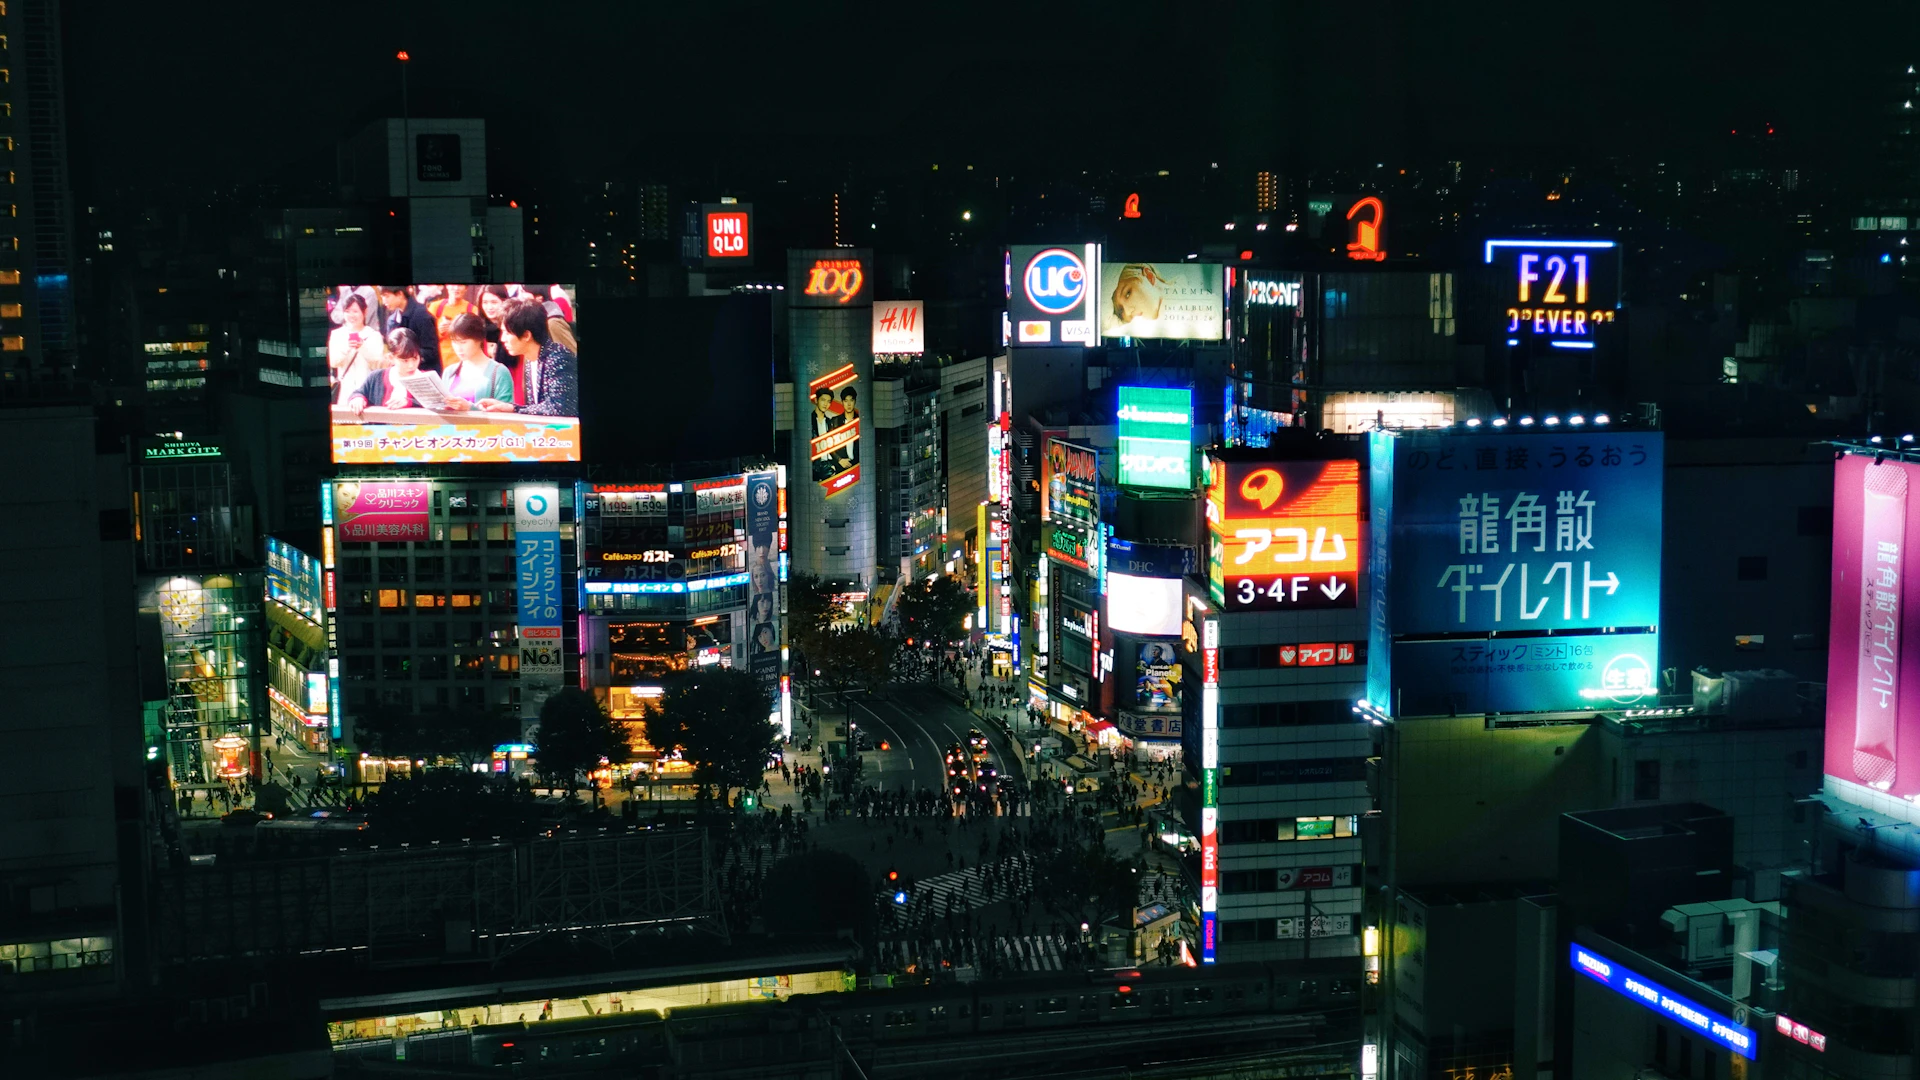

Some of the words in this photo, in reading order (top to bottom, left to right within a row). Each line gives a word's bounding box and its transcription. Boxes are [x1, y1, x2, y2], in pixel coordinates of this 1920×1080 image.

[713, 218, 740, 234] UNI
[714, 236, 744, 253] QLO
[804, 268, 864, 303] 109
[1032, 266, 1082, 298] UC
[1520, 254, 1587, 303] F21
[880, 307, 918, 332] H&M
[1066, 327, 1090, 335] VISA
[532, 438, 556, 447] 12.2
[377, 489, 423, 498] 品川スキン
[377, 499, 419, 508] クリニック
[586, 500, 598, 509] 9F
[521, 518, 554, 527] eyecity
[1459, 490, 1596, 554] 龍角散
[352, 524, 425, 536] 品川美容外科
[720, 544, 743, 557] ガスト
[1236, 527, 1347, 564] アコム
[643, 550, 674, 562] ガスト
[587, 567, 602, 576] 7F
[624, 565, 662, 579] ガスト
[1129, 560, 1154, 572] DHC
[522, 540, 540, 618] アイシティ
[543, 540, 557, 618] コンタクトの
[1437, 561, 1620, 623] ダイレクト
[521, 648, 562, 665] No.1
[1300, 648, 1352, 662] アイフル
[1452, 644, 1528, 662] スティック
[1534, 646, 1564, 658] ミント
[1569, 645, 1593, 656] 16包
[1304, 874, 1330, 882] アコム
[1336, 921, 1348, 930] 3F
[1578, 951, 1610, 977] MIZUHO
